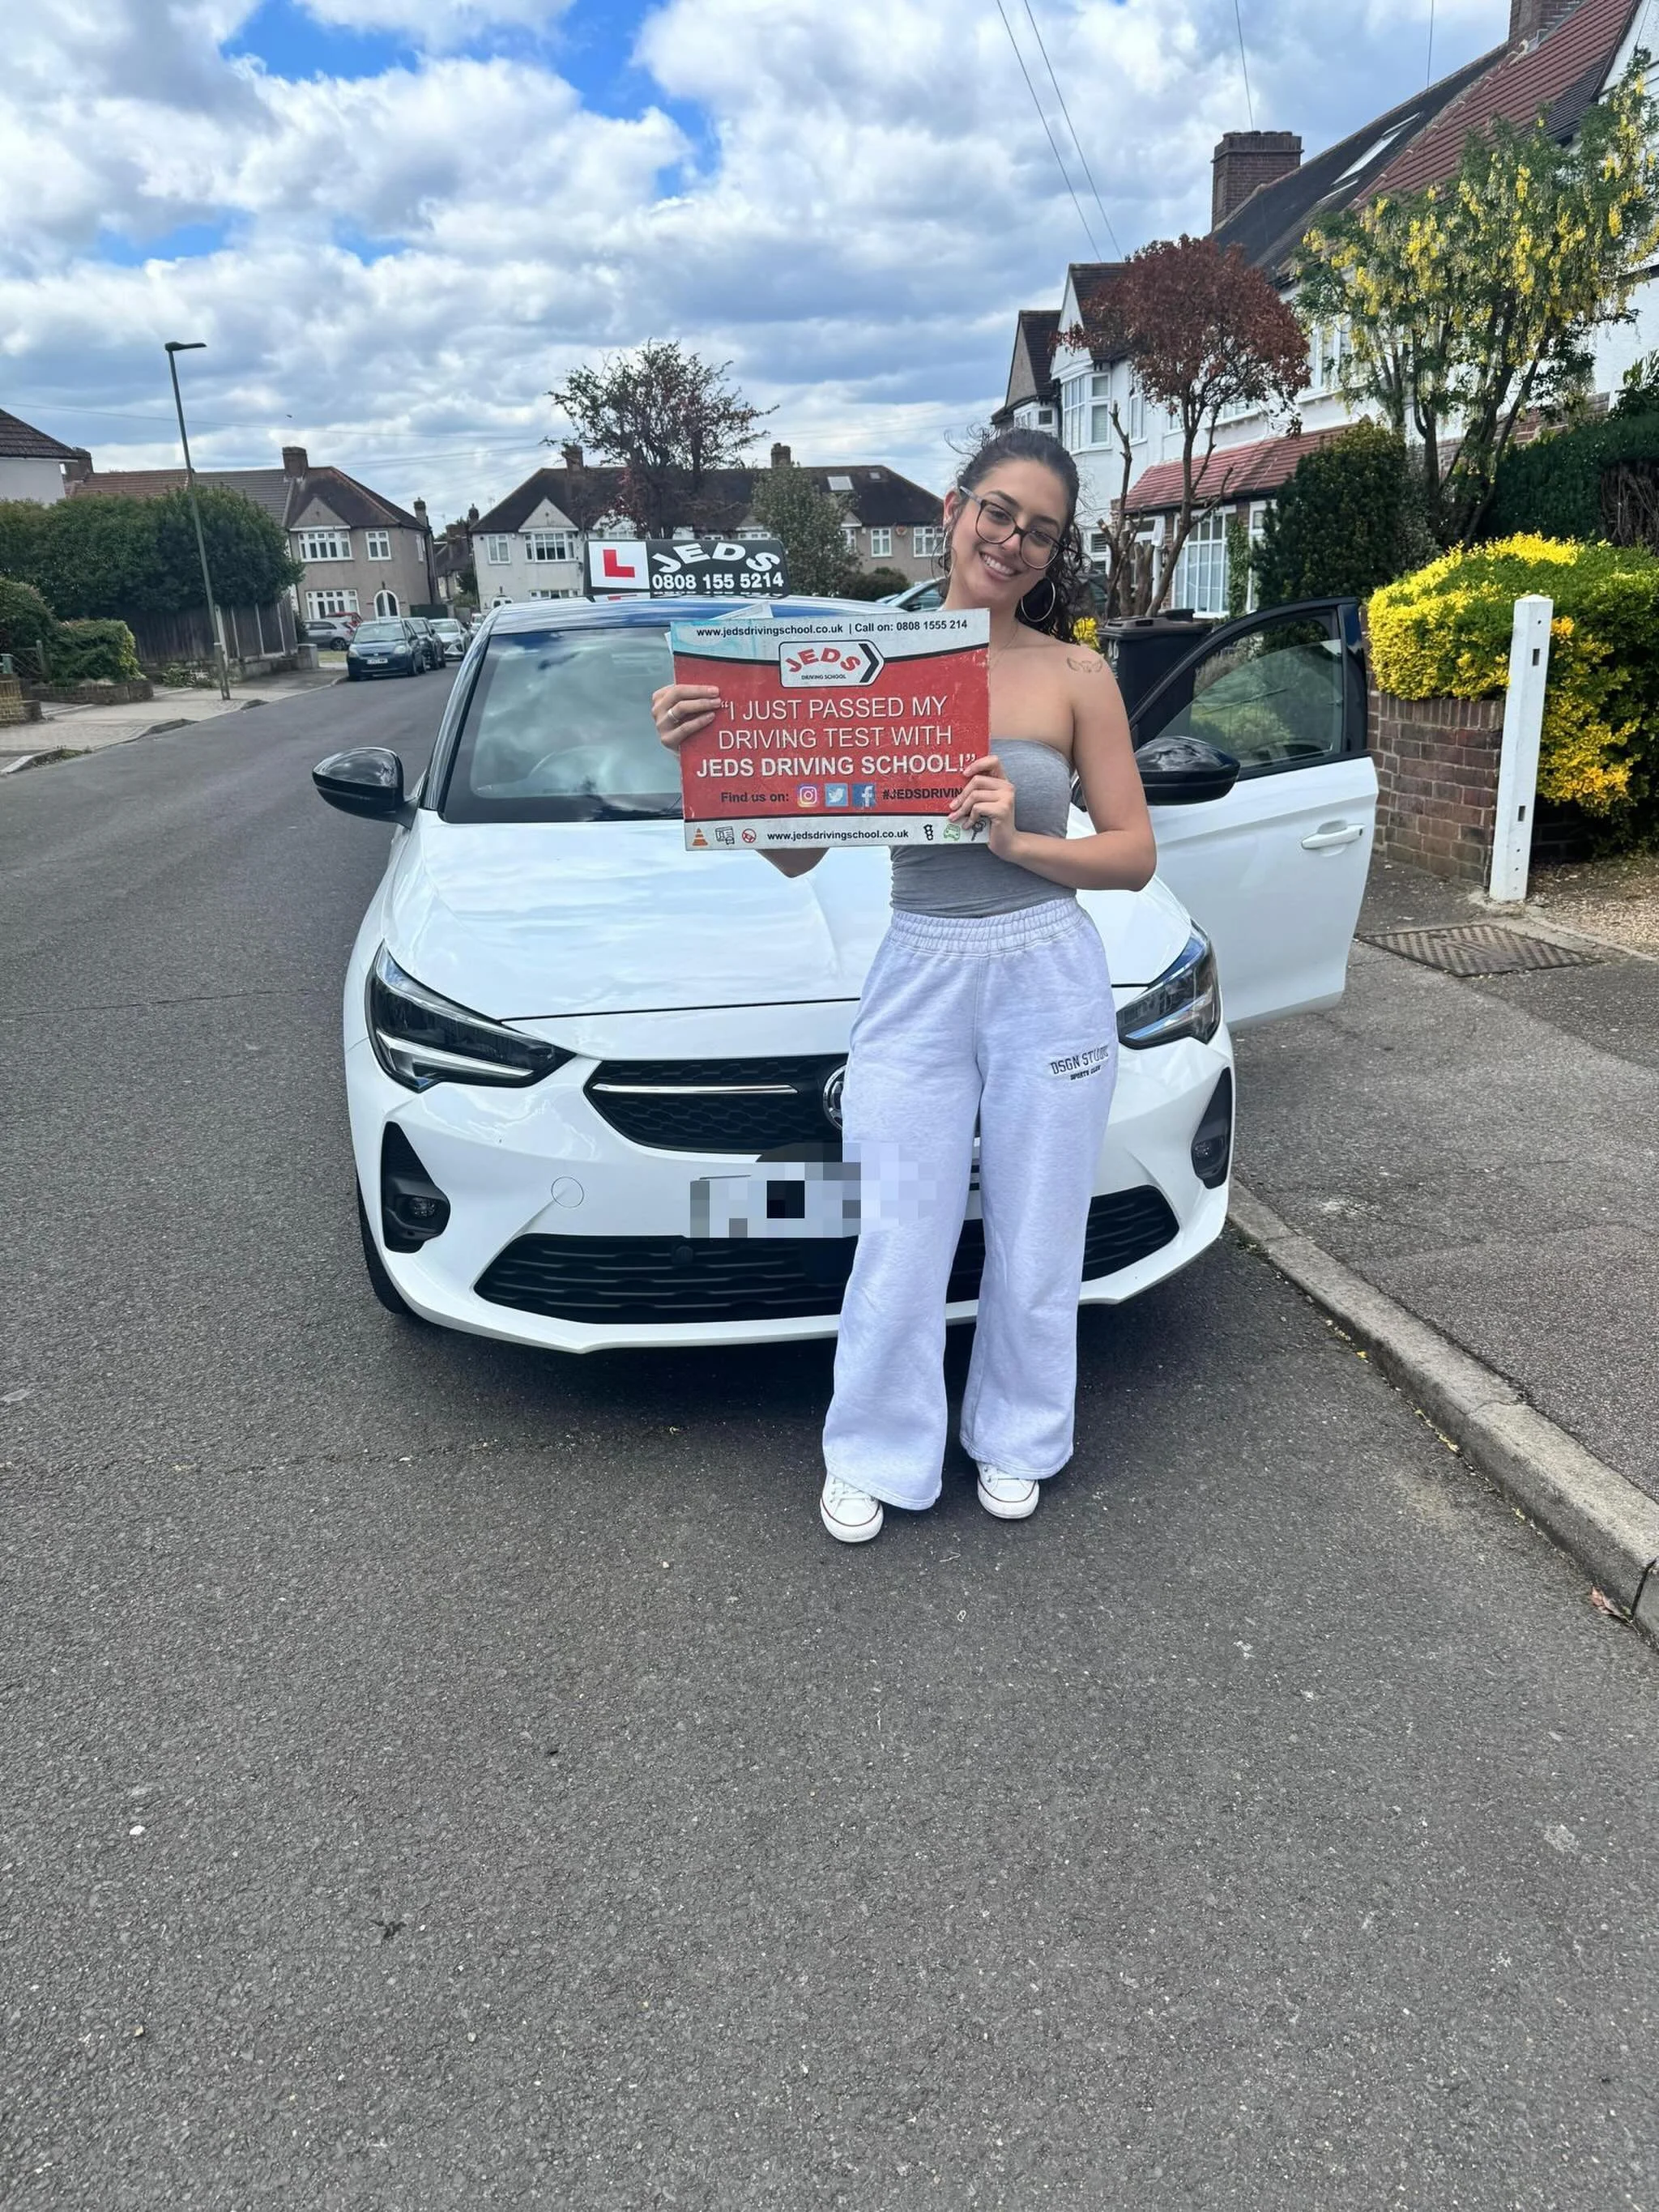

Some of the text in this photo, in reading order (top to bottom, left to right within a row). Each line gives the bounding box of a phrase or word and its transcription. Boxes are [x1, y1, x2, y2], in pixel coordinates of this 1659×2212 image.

[603, 548, 635, 578] L
[652, 542, 781, 573] JEDS
[652, 572, 784, 590] 0808 155 5214
[697, 624, 842, 637] www.jedsdrivingschool.co.uk
[855, 623, 874, 633] Call
[877, 622, 893, 632] on:
[896, 621, 919, 631] 0808
[923, 620, 946, 630] 1555
[950, 620, 967, 629] 214
[783, 647, 860, 672] JEDS
[742, 699, 801, 720] JUST
[809, 697, 903, 718] PASSED
[913, 695, 948, 716] MY
[719, 725, 952, 750] DRIVING TEST WITH
[697, 758, 753, 778] JEDS
[761, 757, 854, 777] DRIVING
[720, 788, 963, 803] Find us on: #JEDSDRIVIN
[767, 829, 909, 842] www.jedsdrivingschool.co.uk
[1051, 1055, 1080, 1074] DSGN
